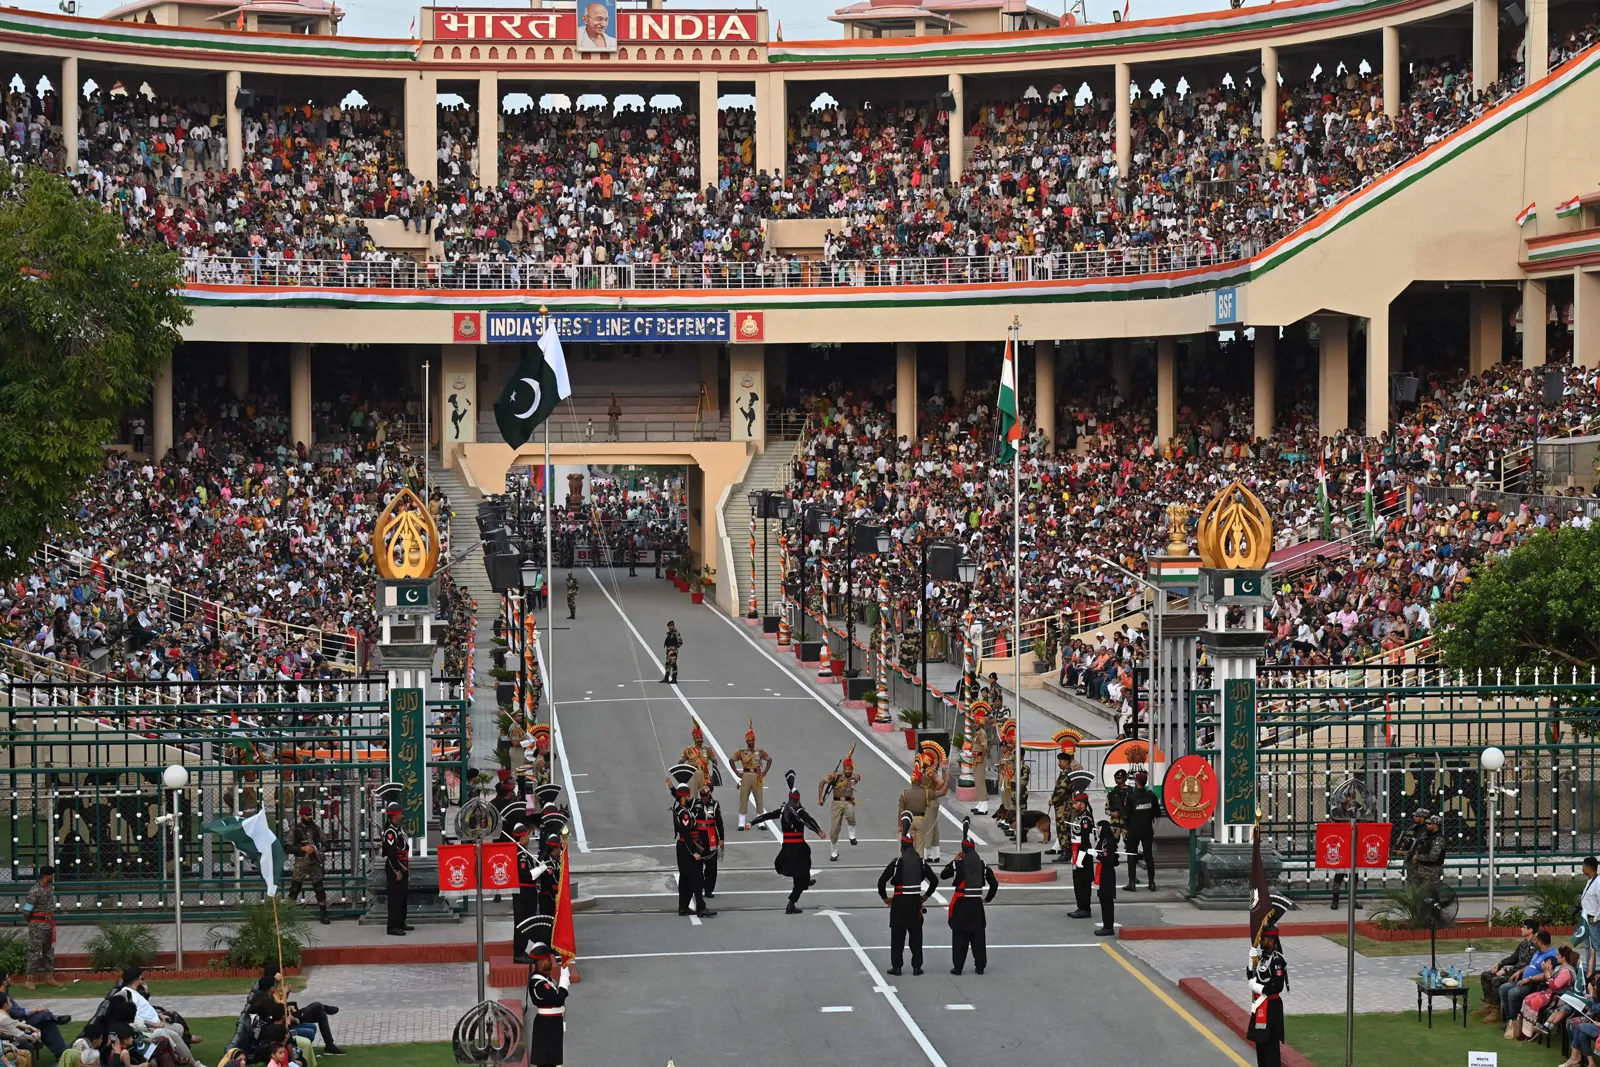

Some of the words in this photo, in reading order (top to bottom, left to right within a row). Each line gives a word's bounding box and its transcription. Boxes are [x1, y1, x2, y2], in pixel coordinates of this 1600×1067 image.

[440, 13, 562, 39] भारत
[629, 14, 750, 40] INDIA
[1218, 293, 1232, 319] BSF
[490, 317, 544, 336] INDIA'S
[596, 317, 631, 336] LINE
[634, 317, 654, 336] OF
[656, 317, 726, 336] DEFENCE
